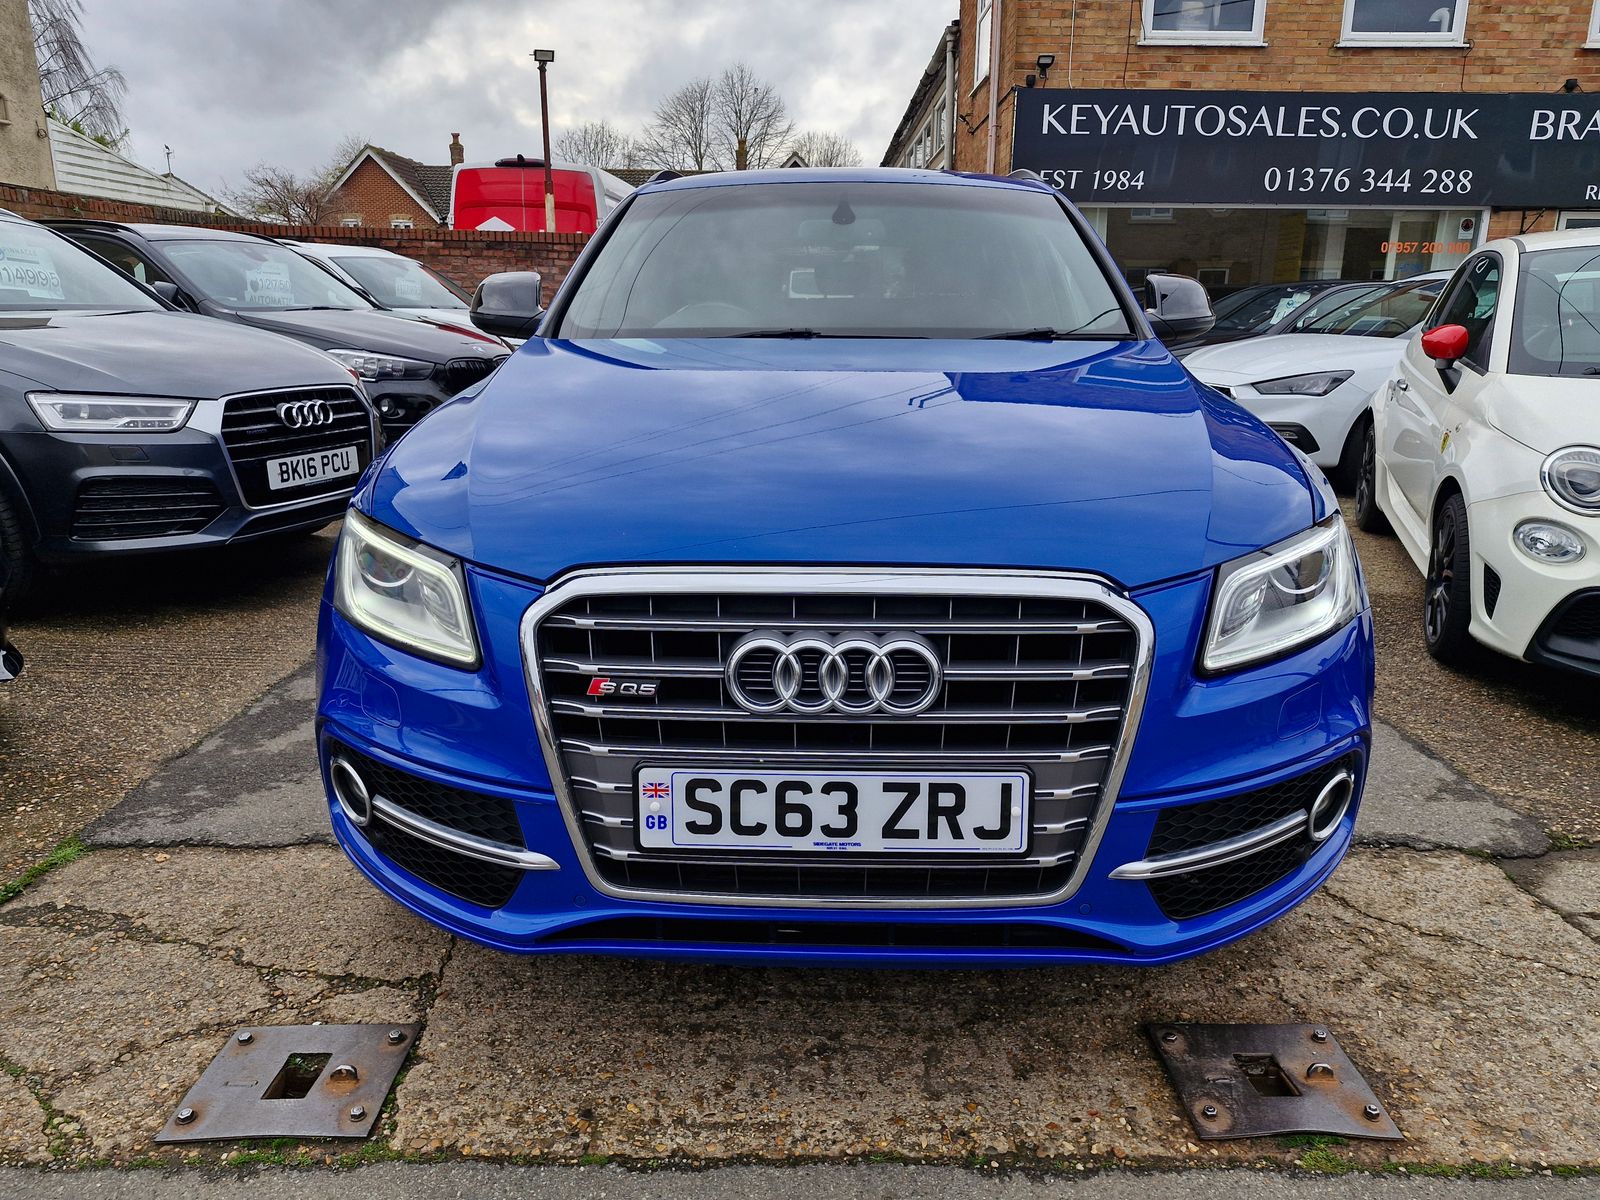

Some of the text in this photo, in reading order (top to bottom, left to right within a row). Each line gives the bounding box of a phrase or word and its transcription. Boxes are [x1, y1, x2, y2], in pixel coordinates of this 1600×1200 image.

[1041, 104, 1479, 139] KEYAUTOSALES.CO.UK
[1040, 170, 1145, 190] EST 1984
[1264, 167, 1473, 194] 01376 344 288
[1381, 241, 1418, 254] 07957
[278, 451, 350, 483] BK16 PCU
[645, 814, 668, 830] GB
[685, 778, 1013, 840] SC63 ZRJ
